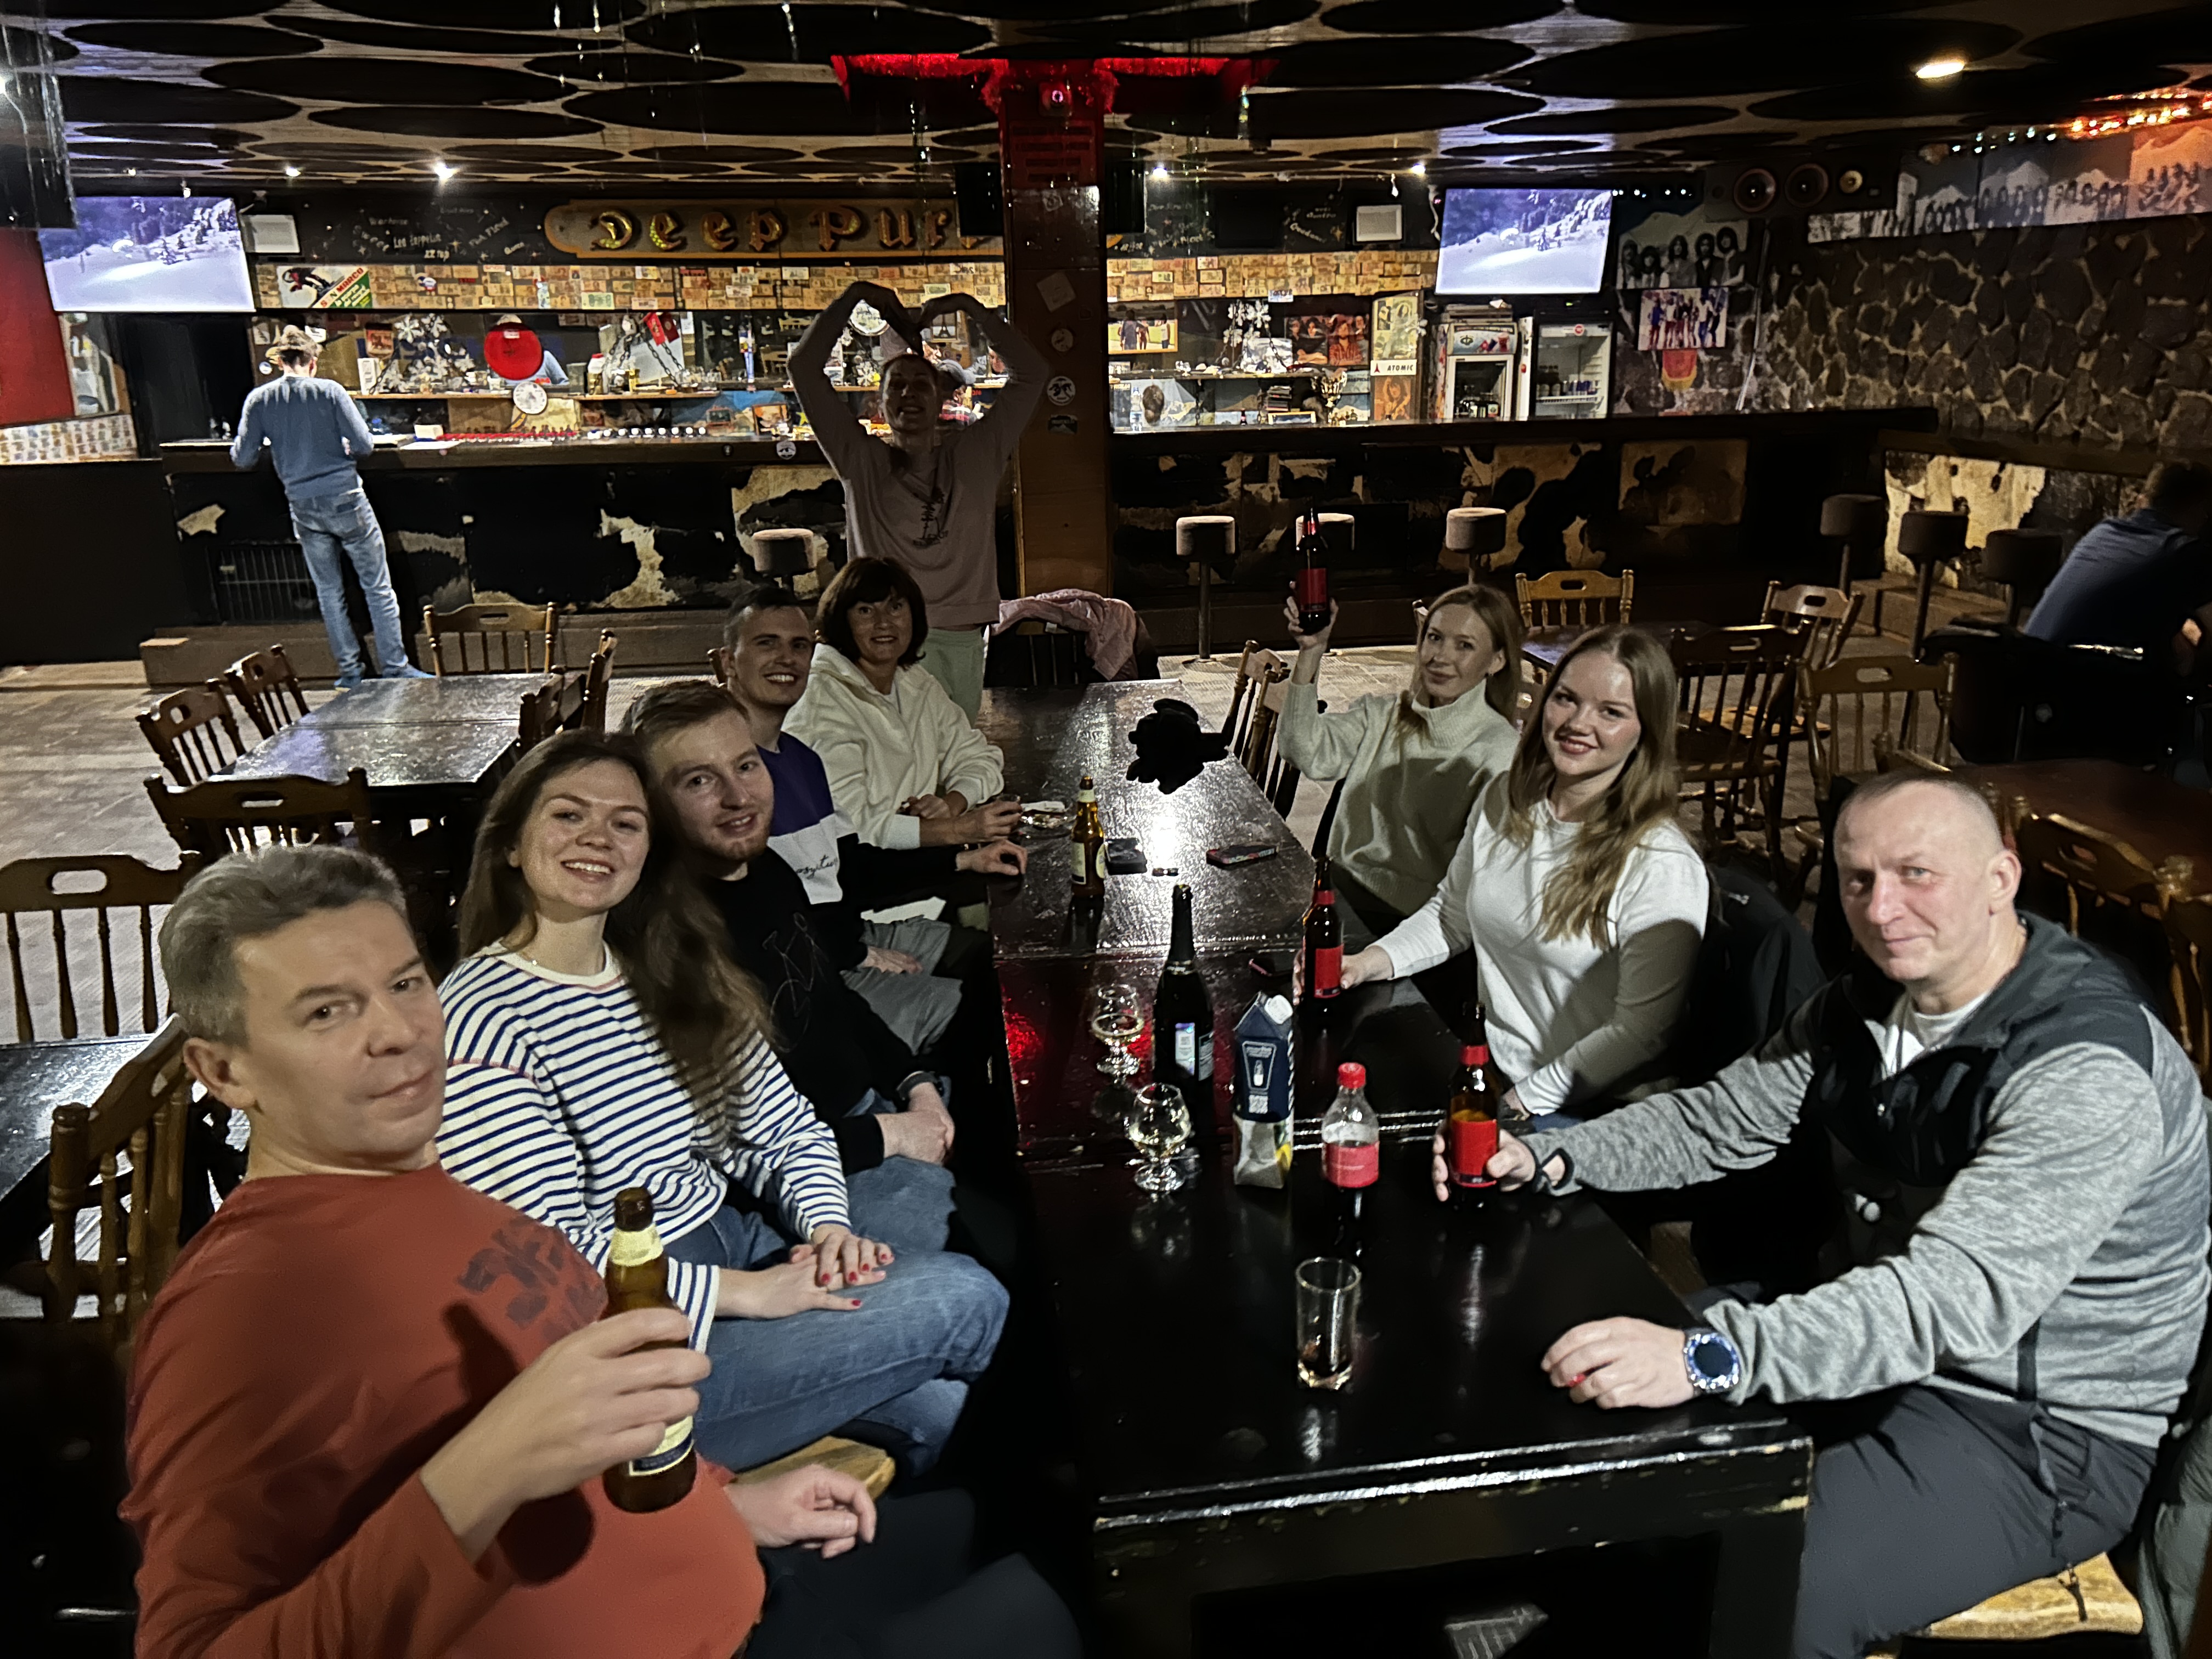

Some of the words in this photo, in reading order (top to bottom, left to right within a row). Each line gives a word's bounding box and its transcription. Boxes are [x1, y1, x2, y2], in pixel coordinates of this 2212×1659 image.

[590, 210, 783, 252] Deep
[809, 205, 986, 252] Pur
[320, 291, 338, 308] SN
[336, 267, 364, 294] MARCO
